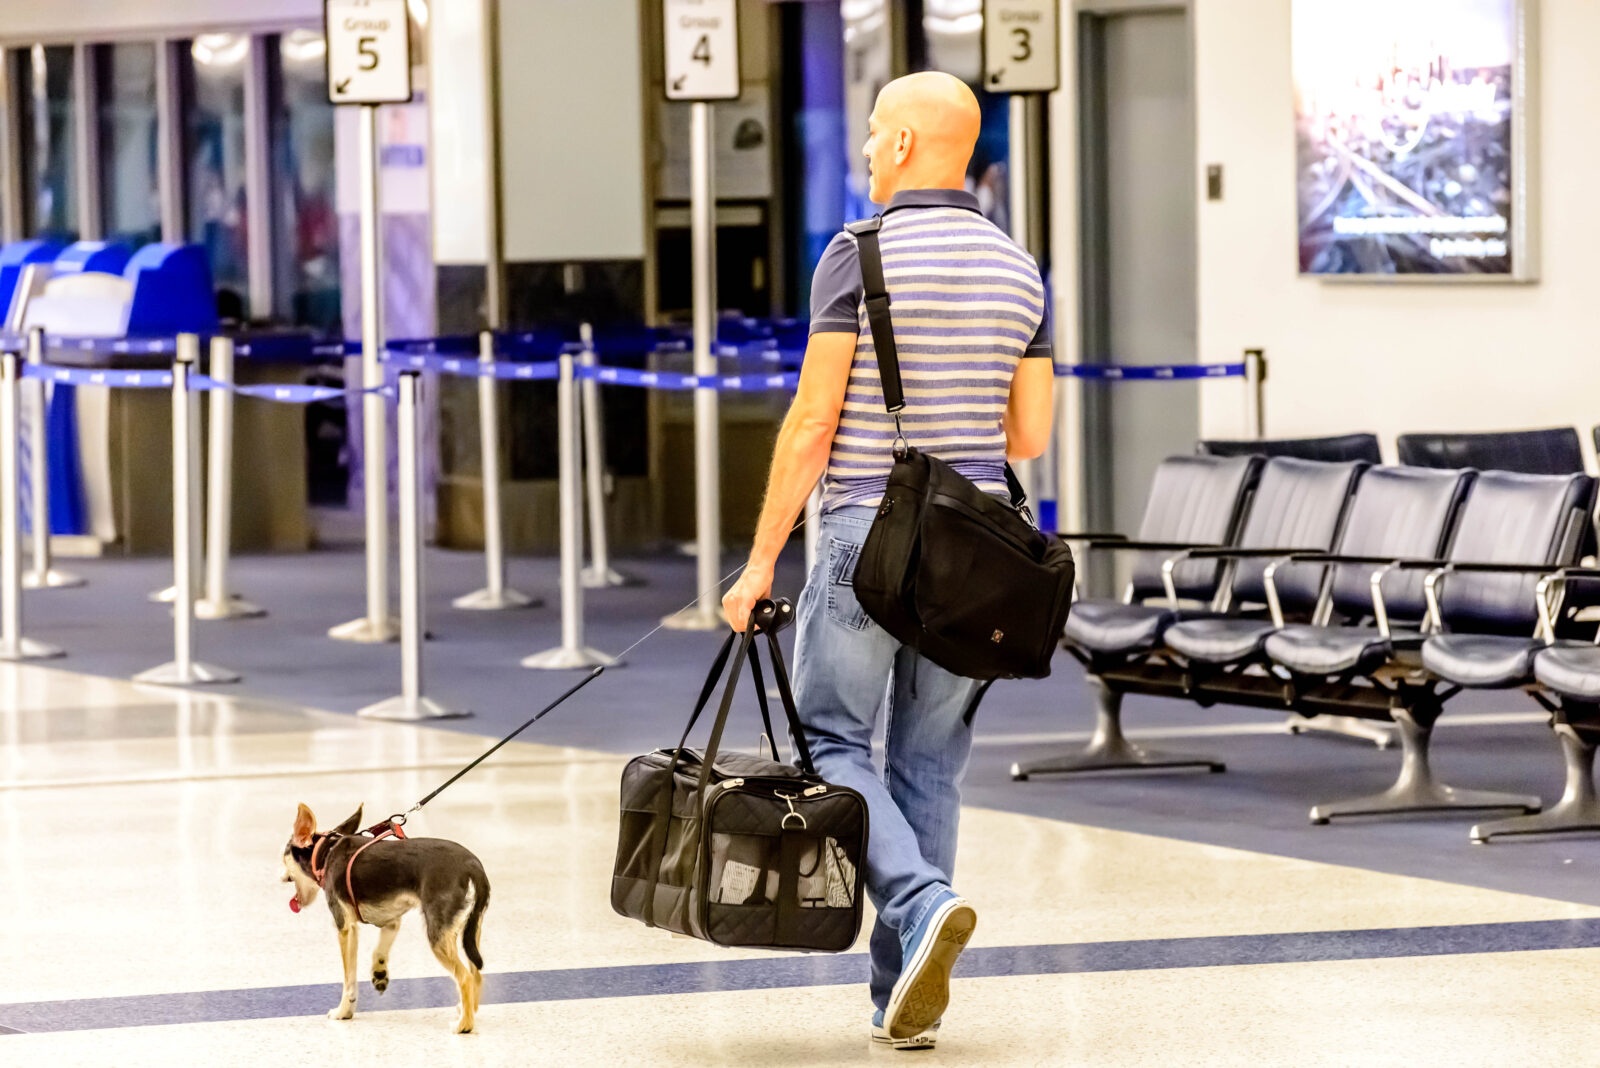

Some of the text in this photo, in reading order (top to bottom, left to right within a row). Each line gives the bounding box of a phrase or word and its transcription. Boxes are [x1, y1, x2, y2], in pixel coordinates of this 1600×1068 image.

[357, 36, 379, 71] 5
[690, 33, 712, 68] 4
[1011, 27, 1032, 62] 3
